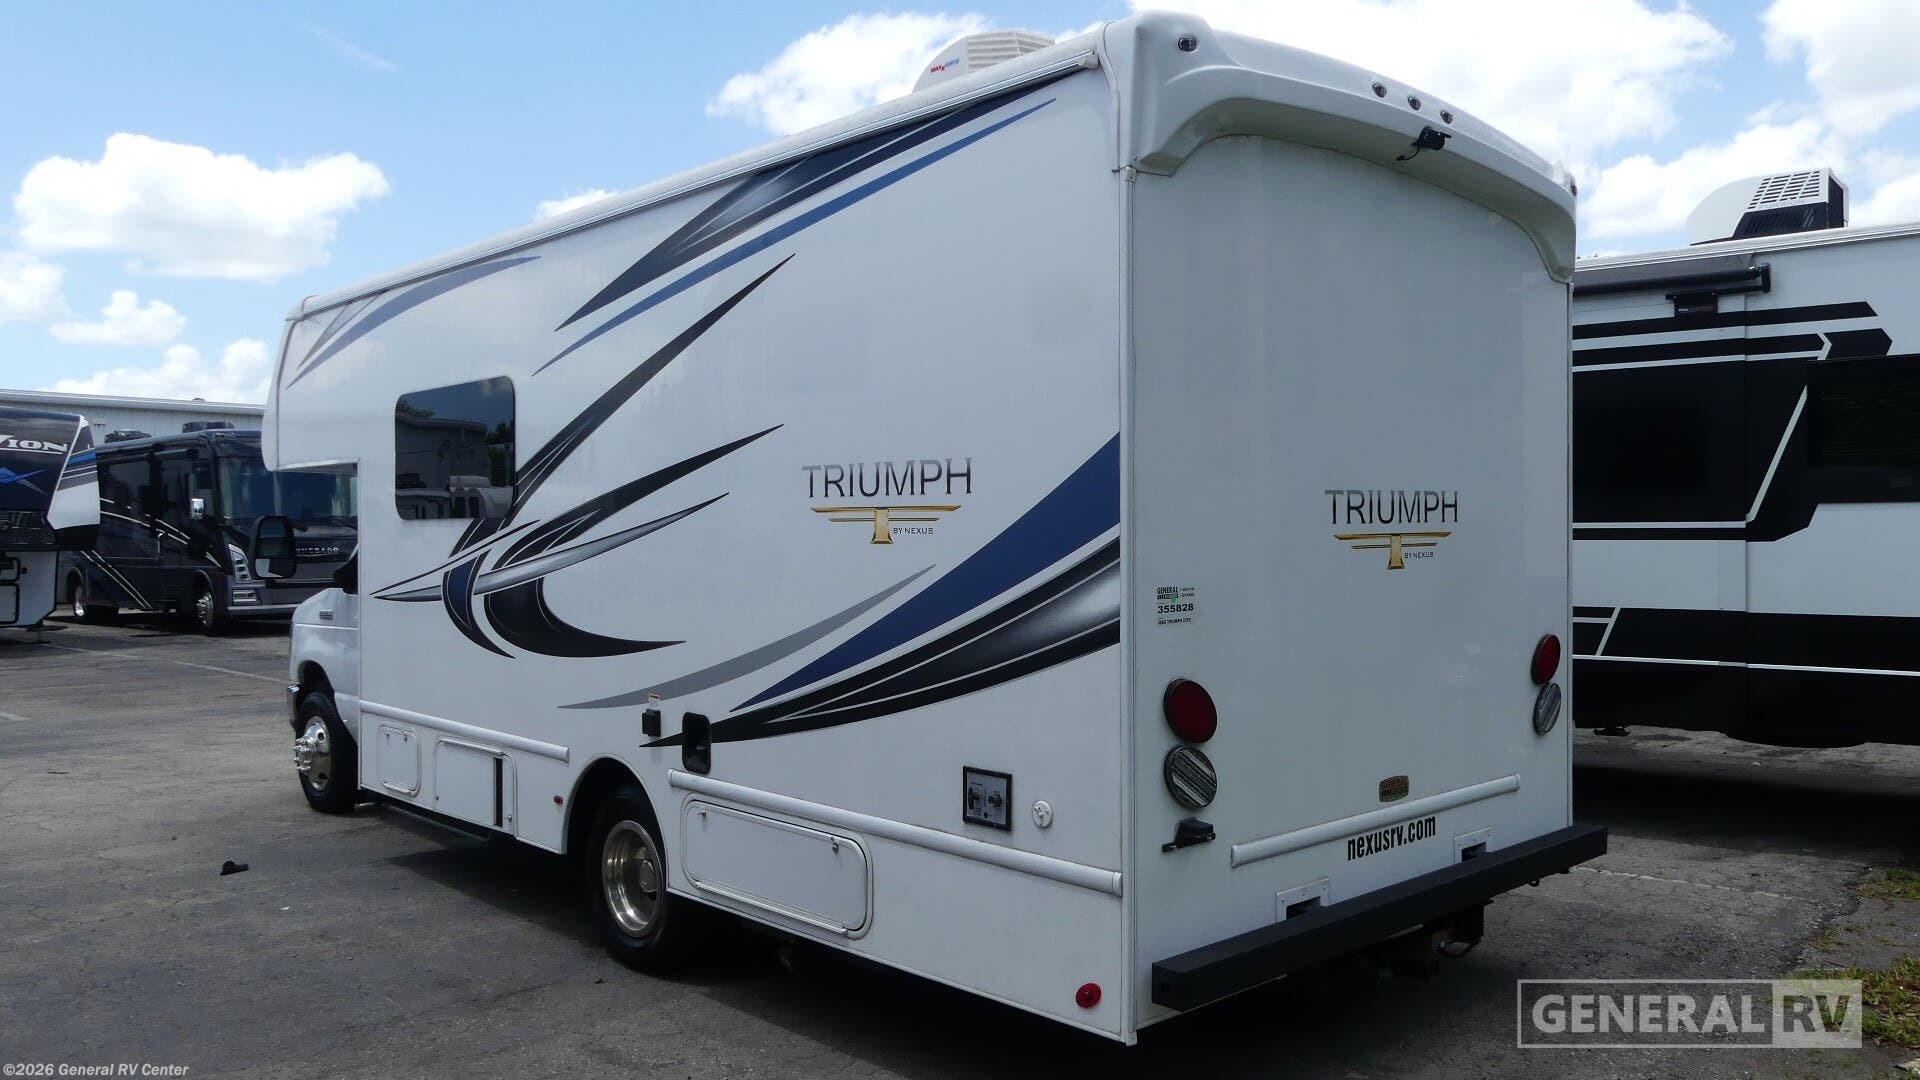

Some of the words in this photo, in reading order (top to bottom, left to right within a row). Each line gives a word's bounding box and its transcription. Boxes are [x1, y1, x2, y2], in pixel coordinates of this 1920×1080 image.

[802, 457, 972, 498] TRIUMPH
[1324, 489, 1458, 525] TRIUMPH
[904, 527, 934, 535] NEXUS
[1413, 551, 1434, 559] NEXUS
[1157, 603, 1194, 614] 355828
[1347, 816, 1436, 861] nexusrv.com
